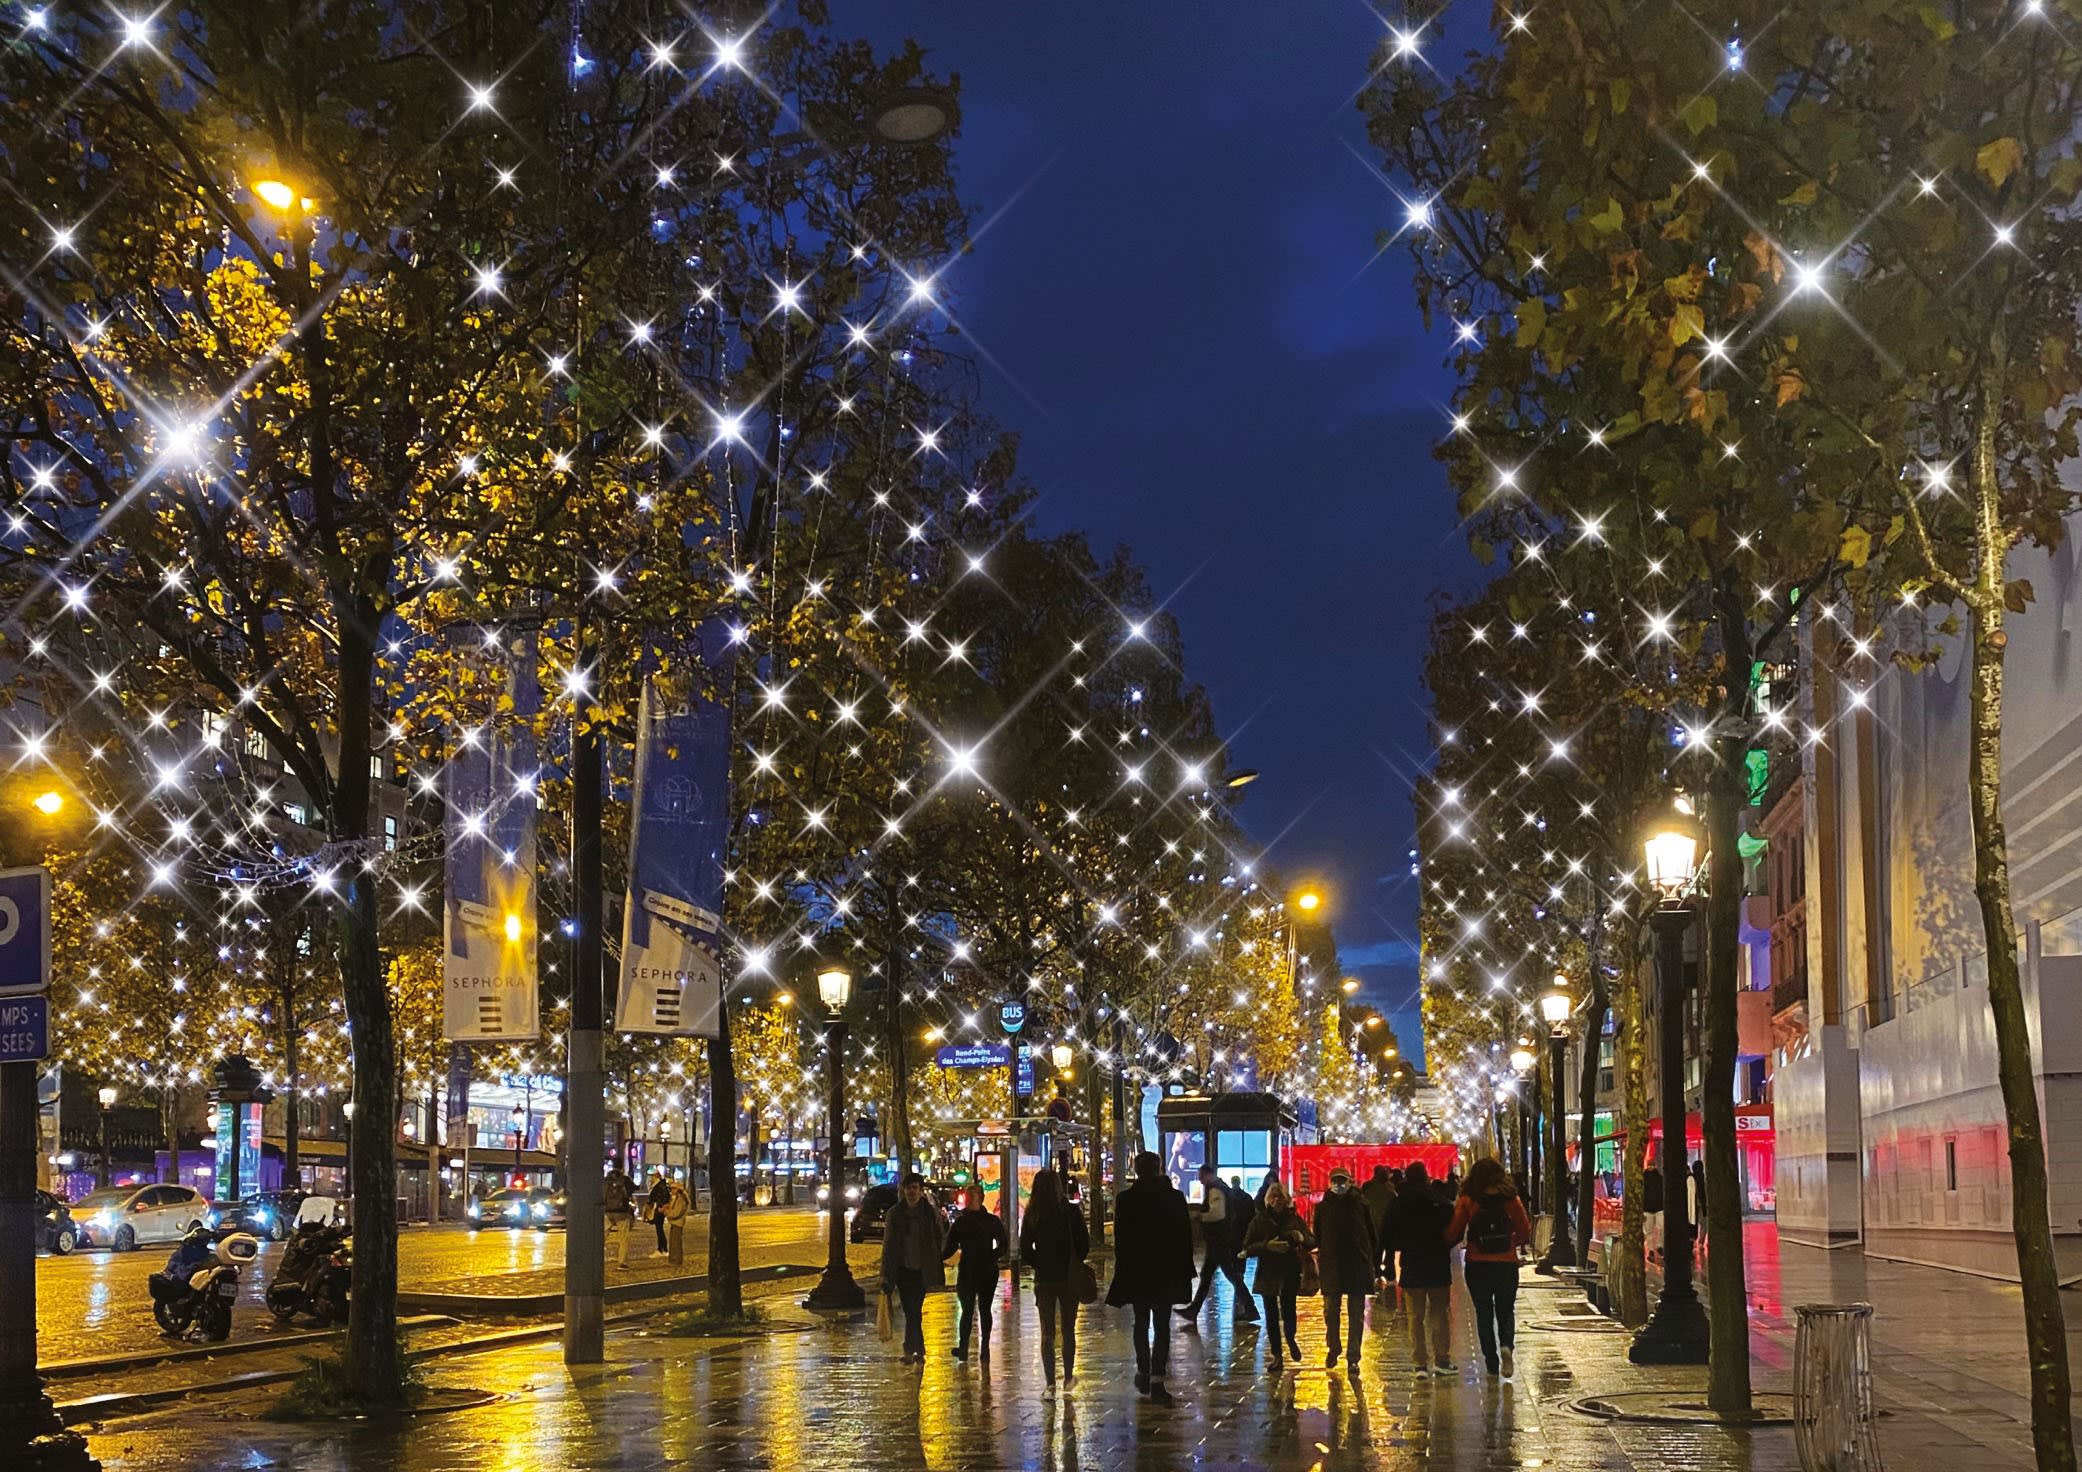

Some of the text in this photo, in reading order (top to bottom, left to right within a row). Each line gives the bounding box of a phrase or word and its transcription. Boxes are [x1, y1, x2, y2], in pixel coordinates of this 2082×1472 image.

[631, 967, 706, 983] SEPHORA
[452, 977, 526, 989] SEPHORA
[1002, 1007, 1022, 1018] BUS
